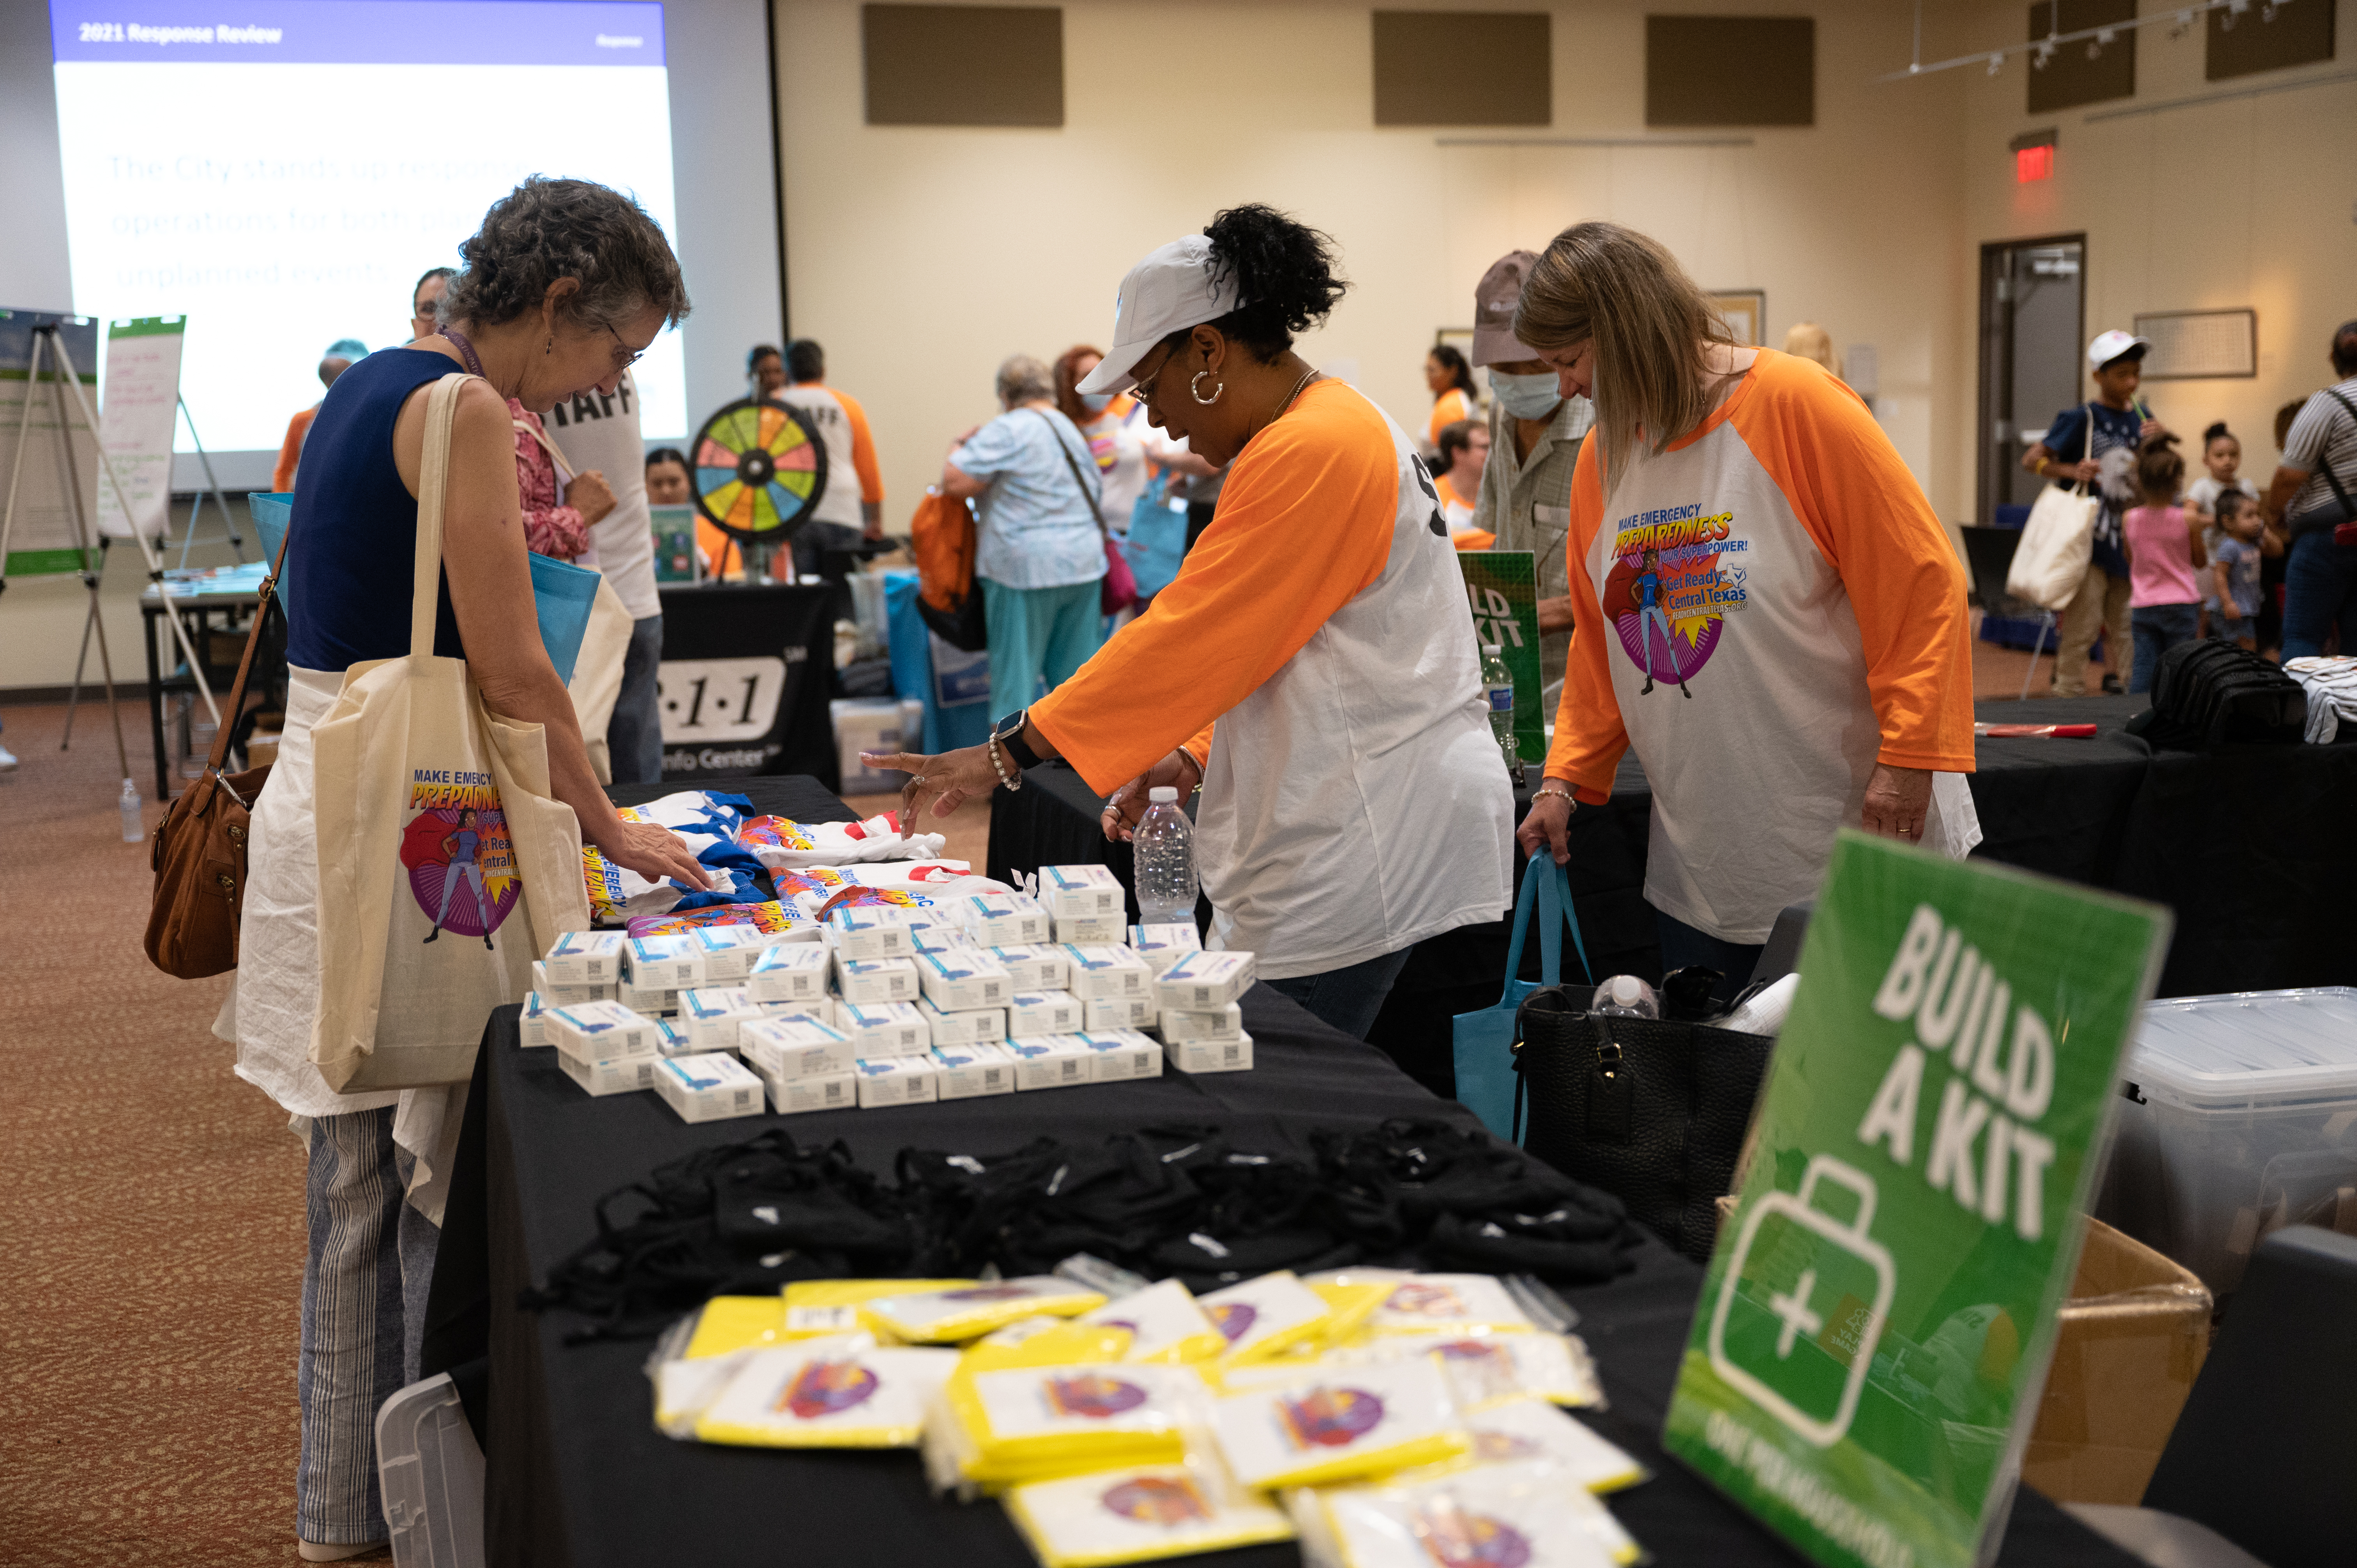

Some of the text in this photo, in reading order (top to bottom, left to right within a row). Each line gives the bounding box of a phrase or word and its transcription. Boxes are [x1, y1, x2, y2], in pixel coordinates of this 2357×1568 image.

[79, 22, 283, 46] 2021 Response Review
[108, 154, 529, 185] The City stands up response
[111, 205, 483, 238] operations for both plan
[117, 261, 389, 292] unplanned events
[1618, 503, 1701, 532] MAKE EMERGENCY
[1611, 512, 1733, 561] PREPAREDNESS
[1659, 540, 1748, 563] YOUR SUPERPOWER!
[1666, 568, 1723, 592] Get Ready
[1668, 589, 1746, 610] Central Texas
[1672, 601, 1747, 620] READYCENTRALTEXAS.ORG
[414, 770, 450, 783] MAKE
[1873, 901, 2055, 1121] BUILD
[1857, 1042, 2056, 1242] A KIT
